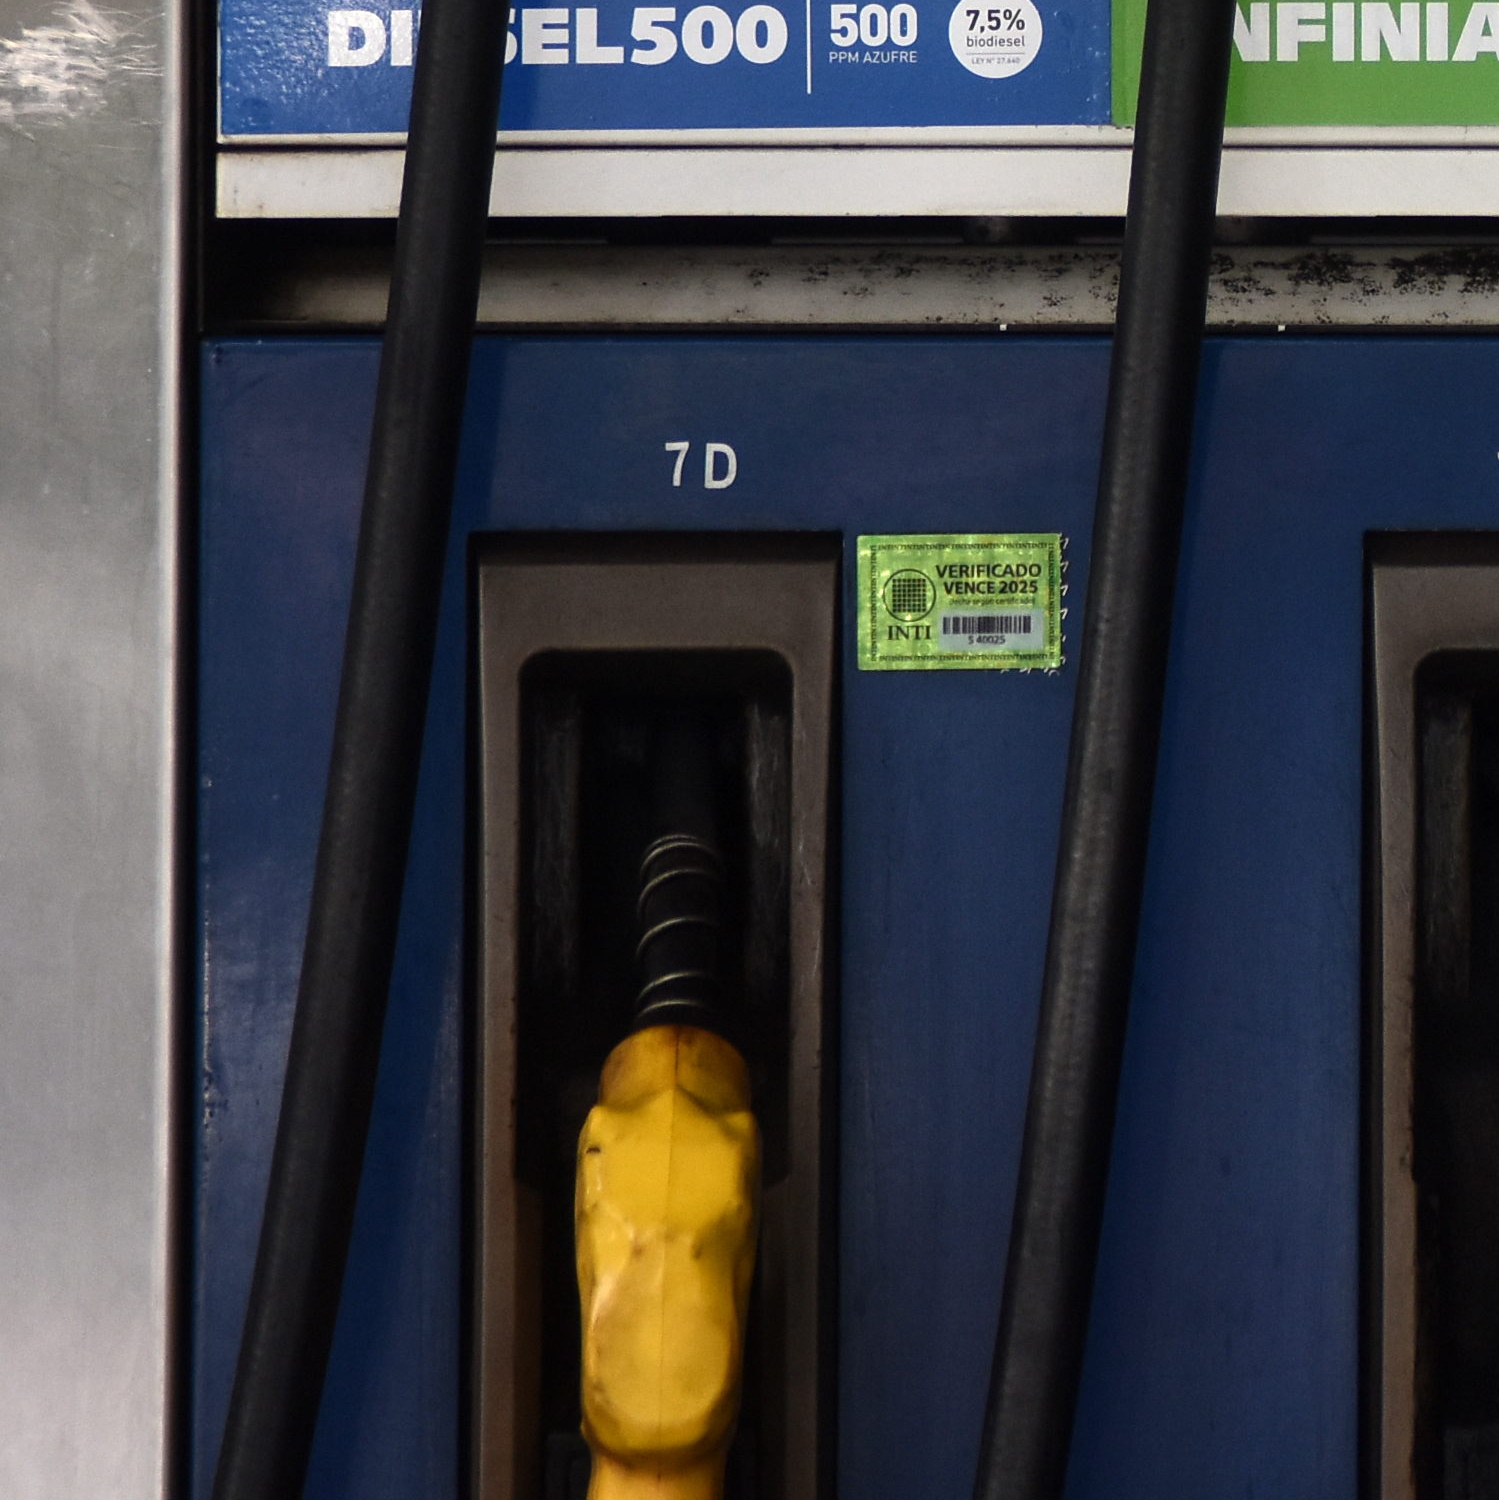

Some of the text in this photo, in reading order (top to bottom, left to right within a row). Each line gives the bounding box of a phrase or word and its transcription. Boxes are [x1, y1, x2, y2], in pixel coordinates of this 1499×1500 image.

[829, 2, 918, 48] 500
[965, 8, 1026, 34] 7,5%
[327, 3, 789, 67] DIEL500
[965, 34, 1026, 48] biodiesel
[828, 50, 918, 65] PPM AZUFRE
[935, 563, 1042, 579] VERIFICADO
[943, 580, 1039, 595] VENCE 2025
[887, 625, 932, 641] INTI
